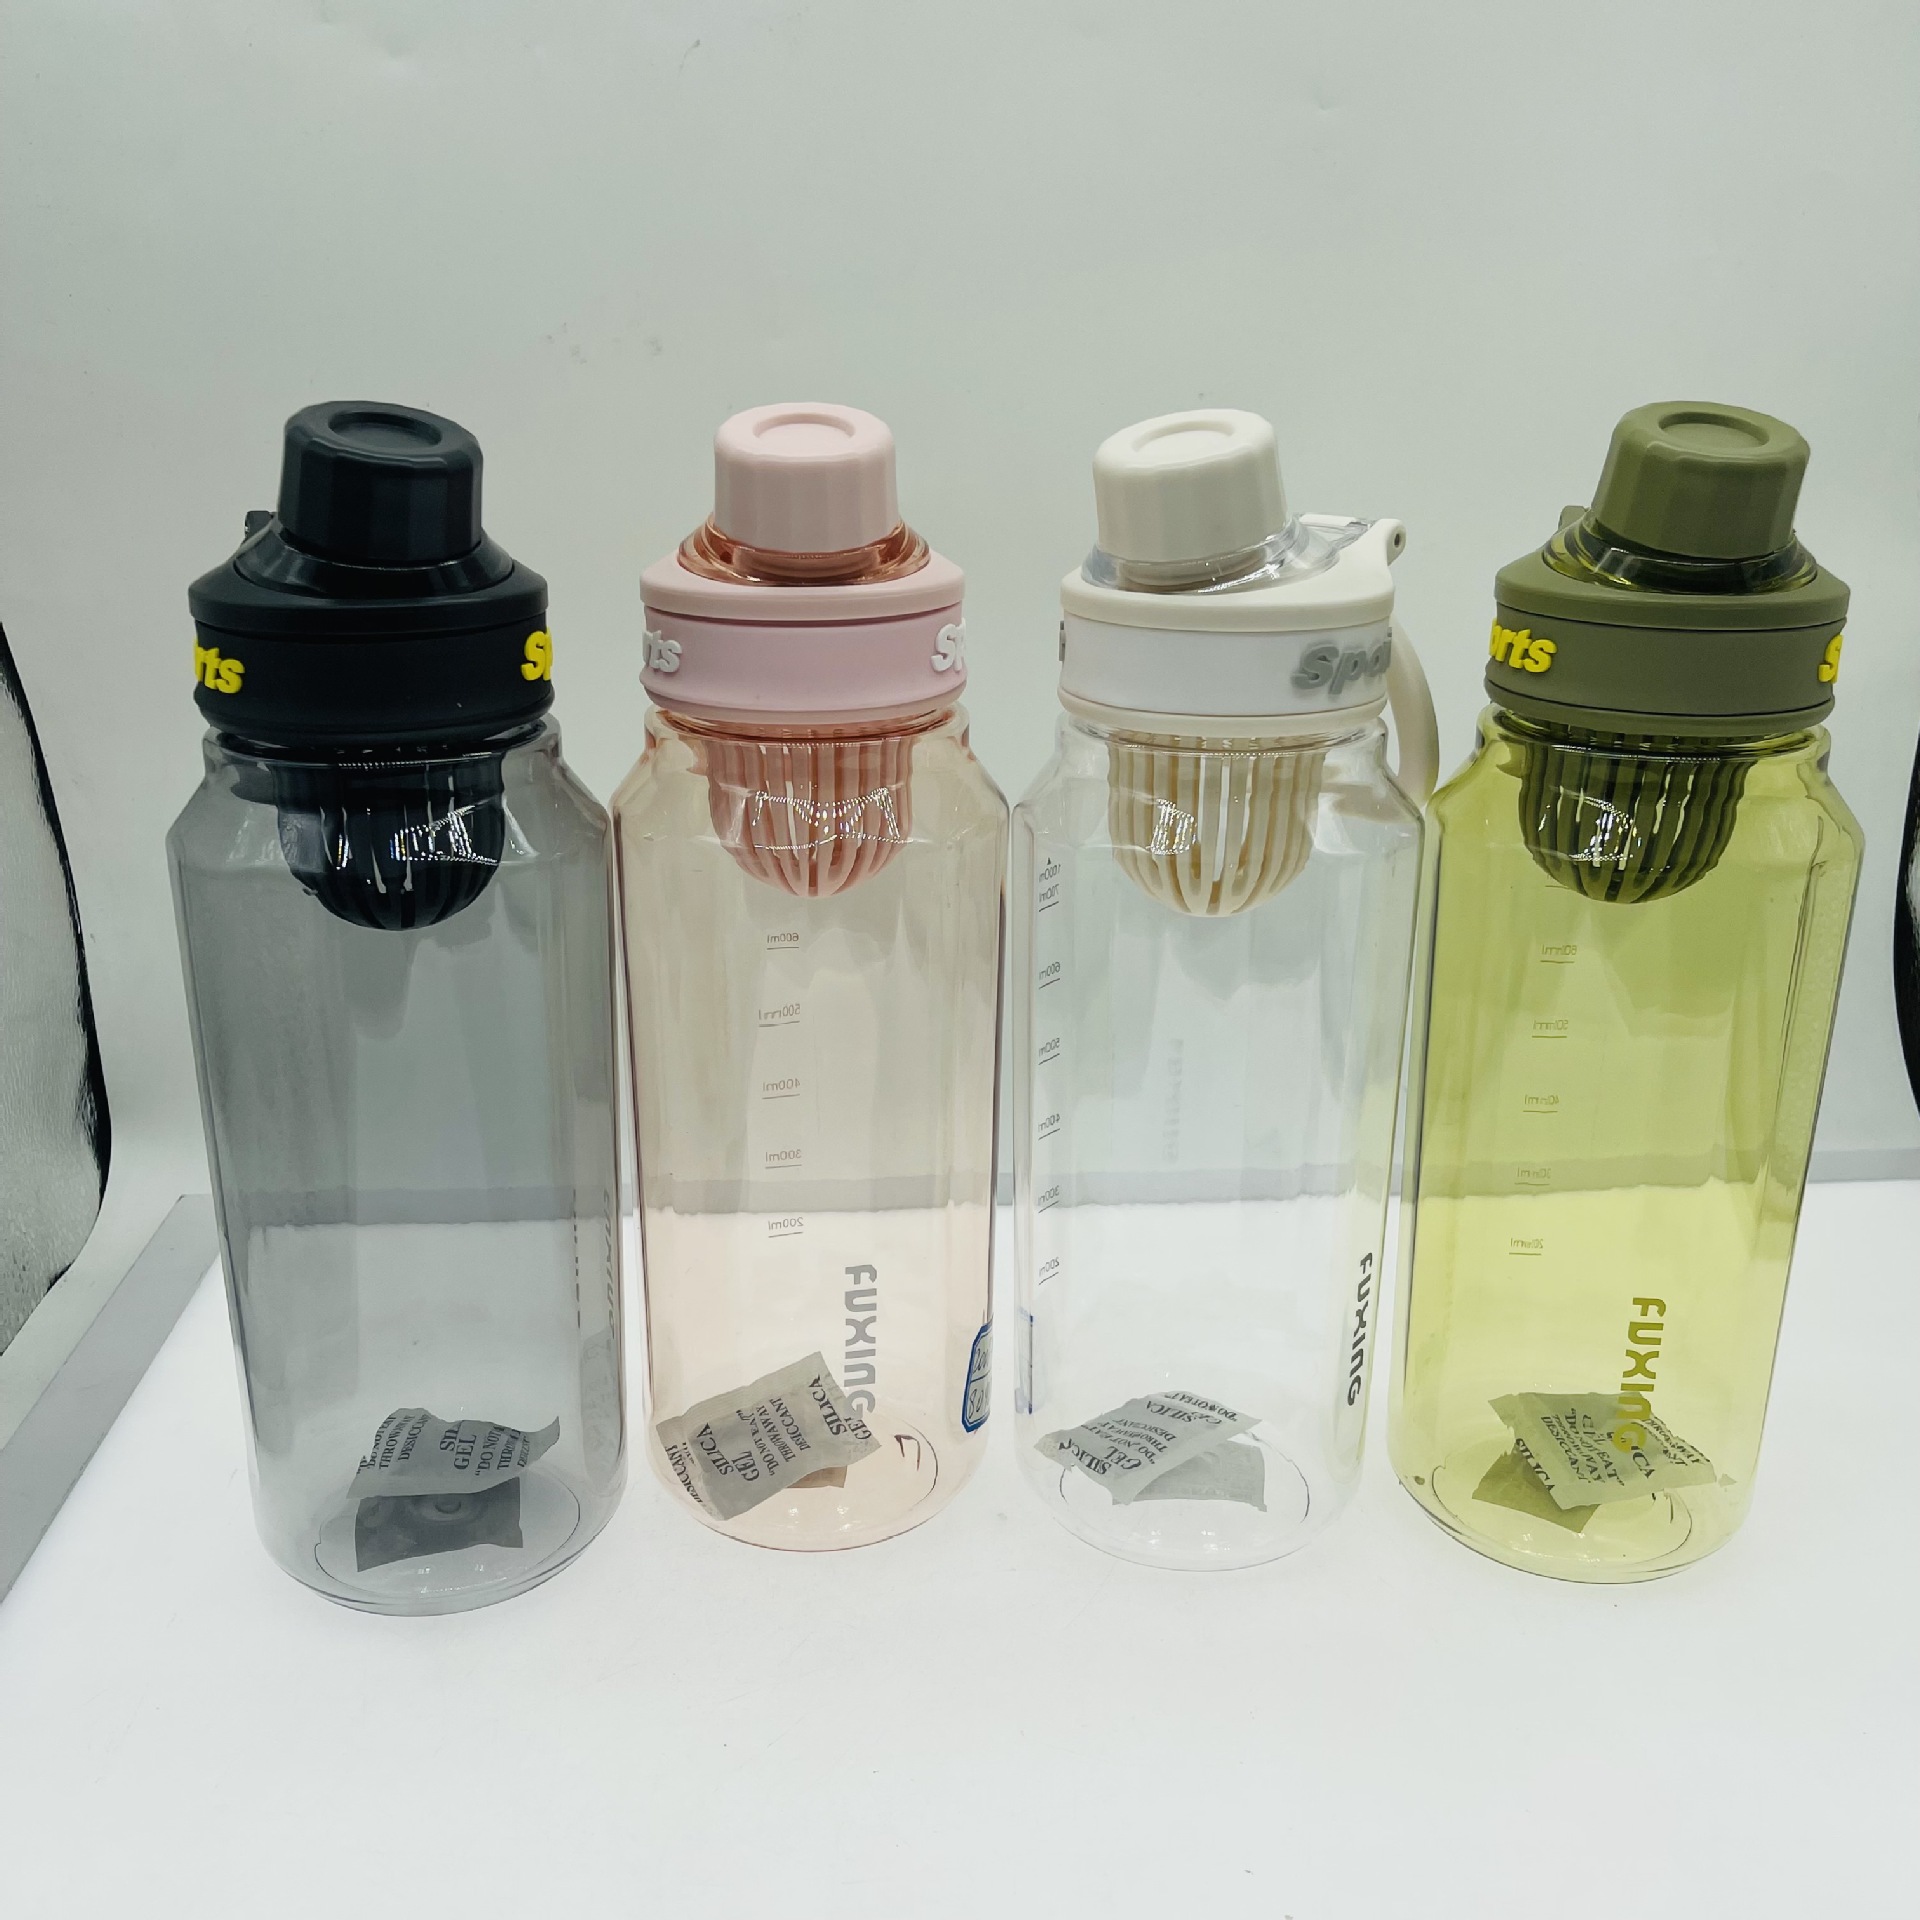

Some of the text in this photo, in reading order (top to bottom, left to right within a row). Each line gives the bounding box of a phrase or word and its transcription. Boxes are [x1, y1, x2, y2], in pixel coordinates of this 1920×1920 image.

[808, 1373, 848, 1436] SILICA
[454, 1434, 477, 1470] GEL
[697, 1422, 734, 1476] SILICA
[731, 1450, 760, 1482] GEL
[1103, 1445, 1142, 1471] GEL
